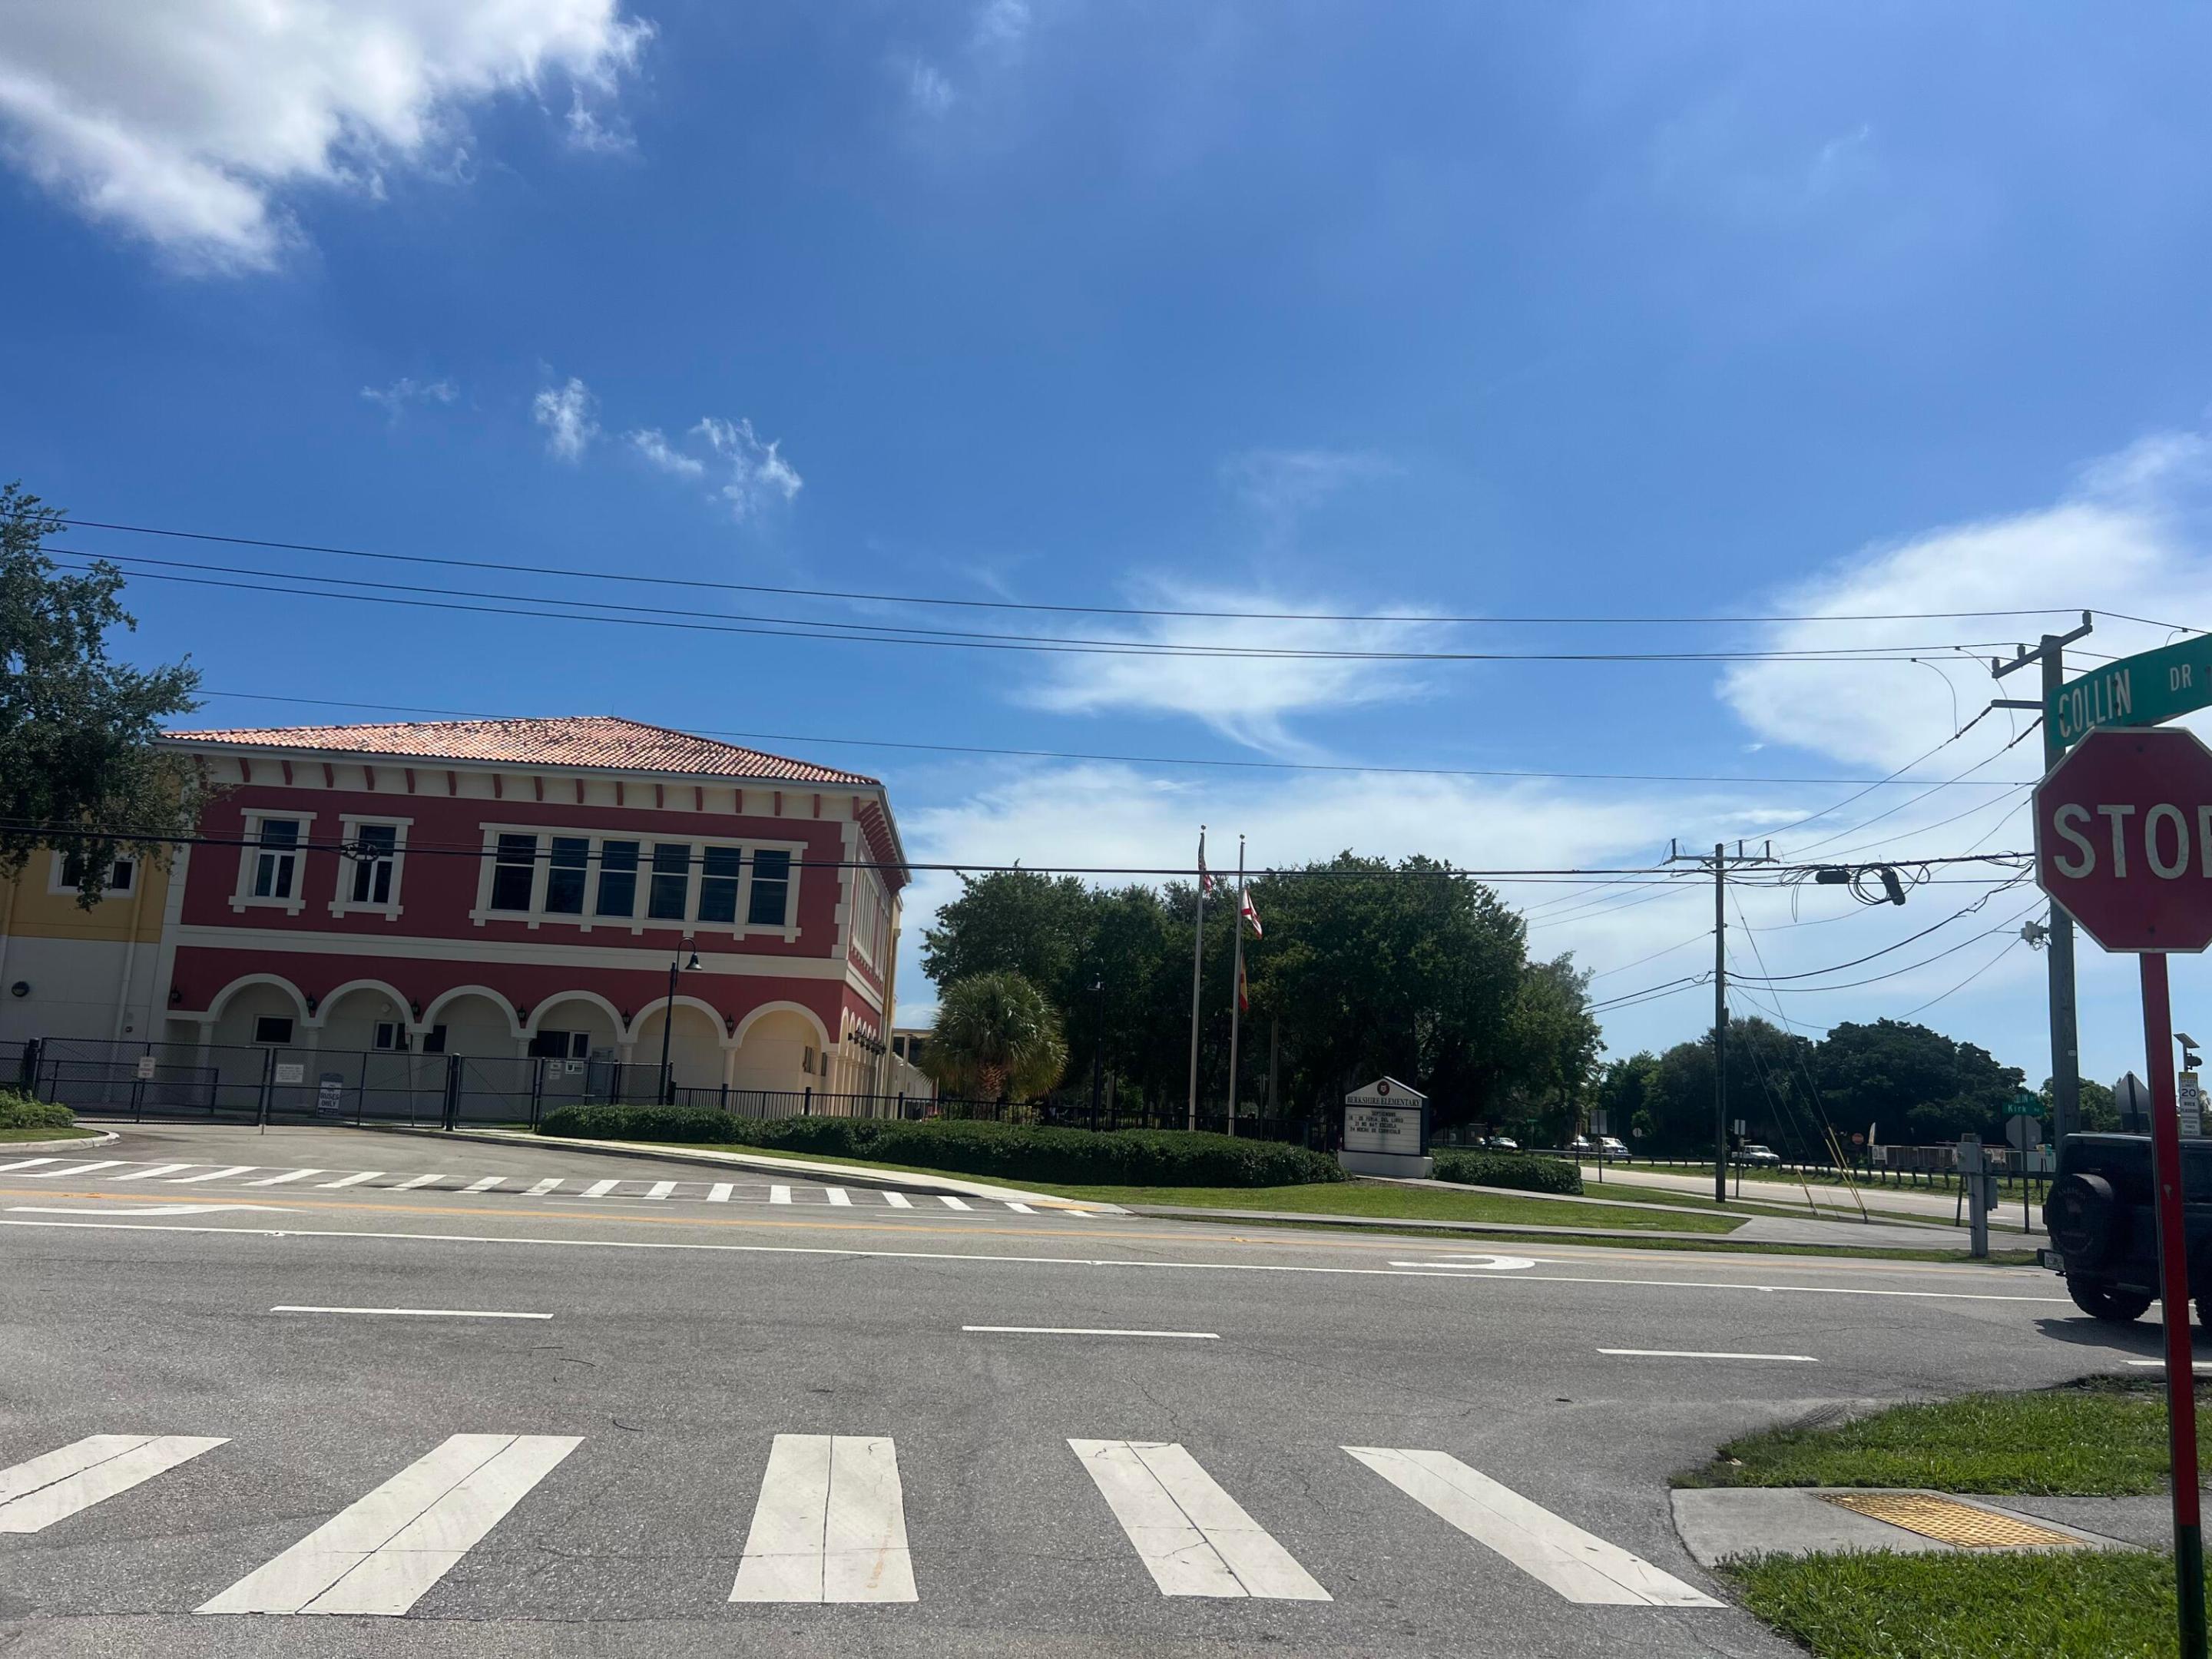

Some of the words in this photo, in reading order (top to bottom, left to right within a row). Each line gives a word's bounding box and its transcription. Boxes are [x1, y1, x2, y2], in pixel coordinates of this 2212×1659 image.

[2058, 668, 2131, 738] COLLIN
[2170, 664, 2192, 691] DR
[2181, 1088, 2197, 1098] 20
[1347, 1096, 1379, 1104] BERKSHIRE
[1381, 1098, 1420, 1107] ELEMENTARY
[2008, 1104, 2027, 1113] Kirk
